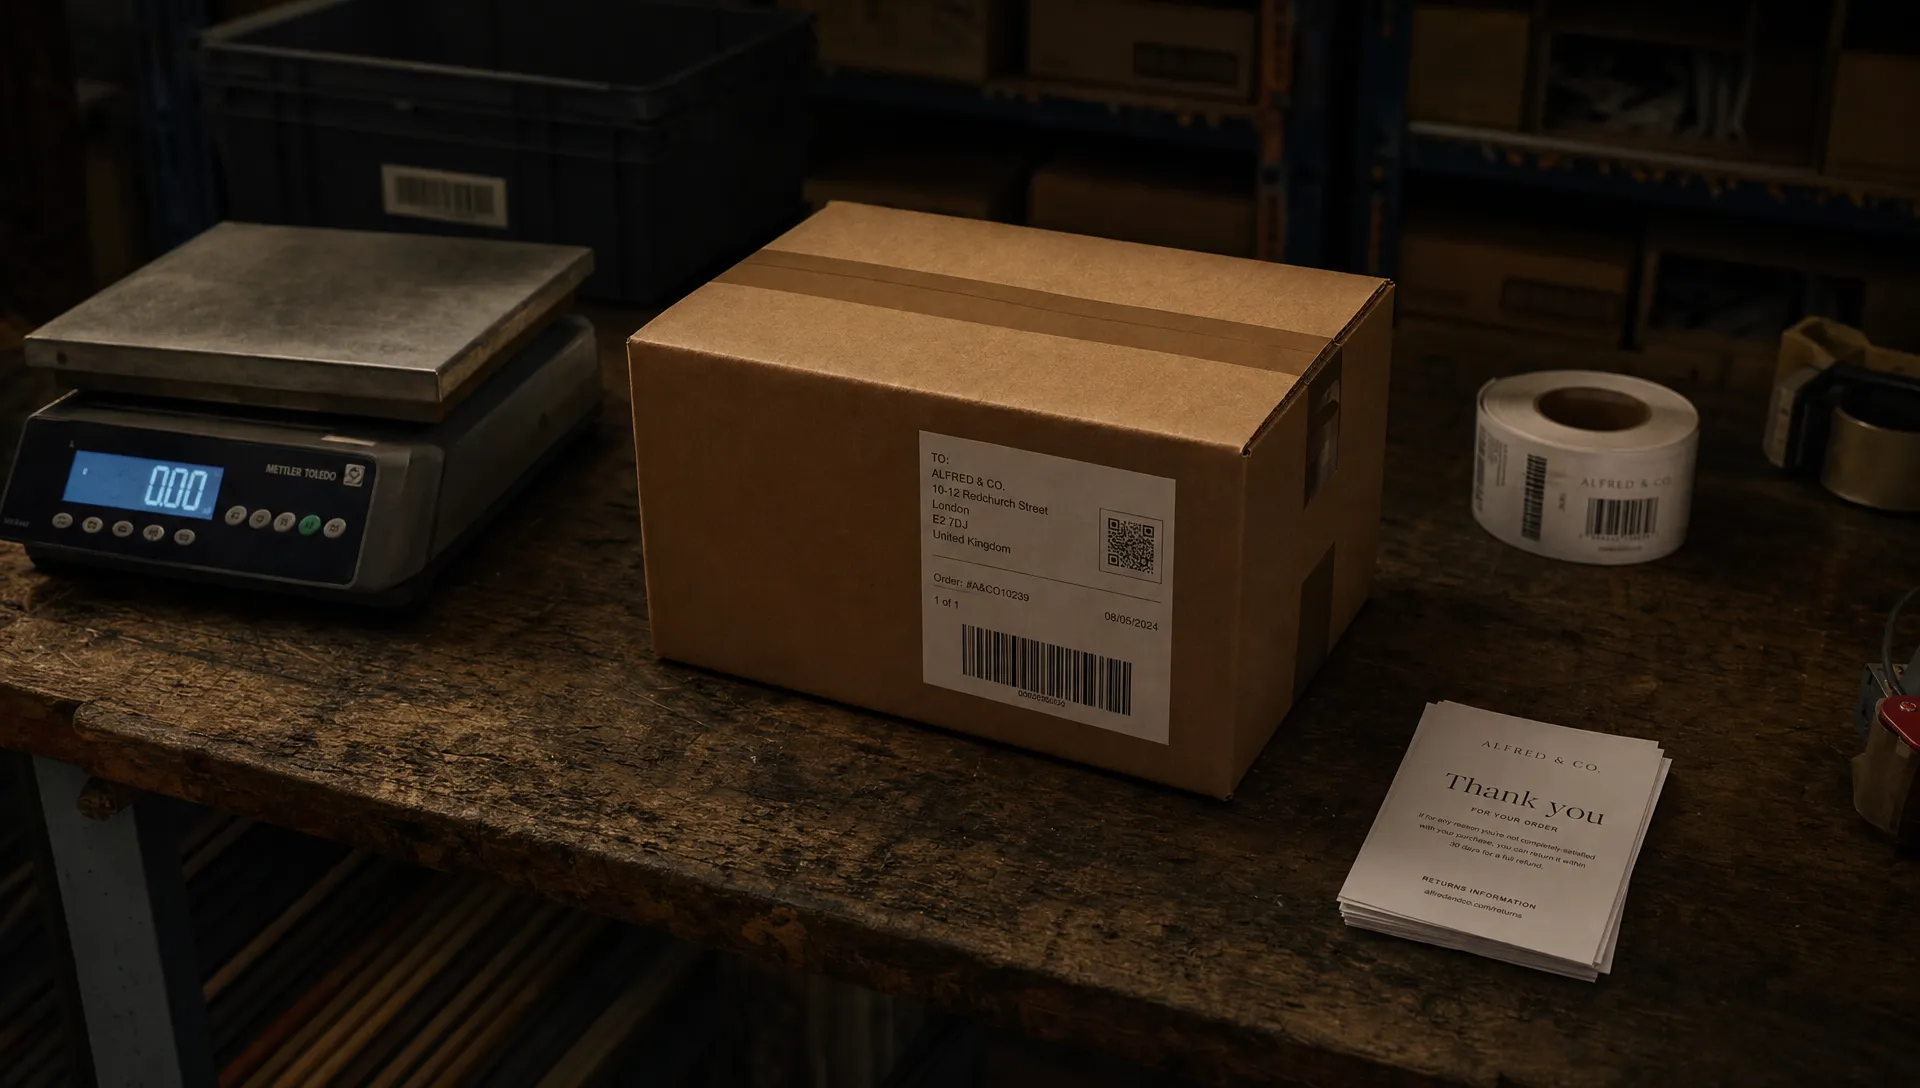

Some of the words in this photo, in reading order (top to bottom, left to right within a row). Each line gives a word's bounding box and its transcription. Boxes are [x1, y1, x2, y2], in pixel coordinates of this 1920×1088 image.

[931, 452, 950, 465] TO:
[265, 463, 301, 477] METTLER
[305, 468, 337, 482] TOLEDO
[931, 469, 974, 484] ALFRED
[976, 477, 984, 487] &
[986, 479, 1006, 491] CO.
[1580, 477, 1635, 489] ALFRED
[1641, 479, 1648, 487] &
[144, 465, 208, 511] 0.00
[932, 484, 960, 498] 10-12
[963, 490, 1016, 508] Redchurch
[1018, 501, 1049, 515] Street
[932, 499, 970, 515] London
[932, 515, 946, 525] E2
[949, 517, 969, 530] 7DJ
[932, 529, 965, 544] United
[967, 537, 1011, 554] Kingdom
[933, 573, 963, 587] Order:
[966, 580, 1030, 602] #A&CO10239
[934, 595, 939, 604] 1
[942, 599, 951, 607] of
[954, 601, 959, 609] 1
[1481, 739, 1547, 761] ALFRED
[1554, 756, 1565, 765] &
[1573, 760, 1601, 773] CO.
[1445, 772, 1539, 810] Thank
[1545, 801, 1604, 825] you
[1471, 807, 1491, 817] FOR
[1494, 813, 1521, 823] YOUR
[1524, 820, 1559, 832] ORDER
[1419, 823, 1435, 832] with
[1436, 828, 1454, 837] your
[1456, 833, 1494, 847] purchase,
[1496, 842, 1512, 851] you
[1530, 850, 1554, 861] return
[1563, 857, 1586, 868] within
[1425, 813, 1436, 821] for
[1438, 818, 1452, 826] any
[1454, 821, 1479, 832] reason
[1506, 834, 1519, 842] not
[1521, 837, 1561, 852] completely
[1562, 848, 1596, 860] satisfied
[1461, 844, 1480, 853] days
[1482, 849, 1493, 857] for
[1502, 853, 1514, 862] full
[1516, 857, 1544, 869] refund.
[1421, 875, 1467, 892] RETURNS
[1470, 888, 1536, 910] INFORMATION
[1423, 889, 1523, 919] alfredandco.com/returns
